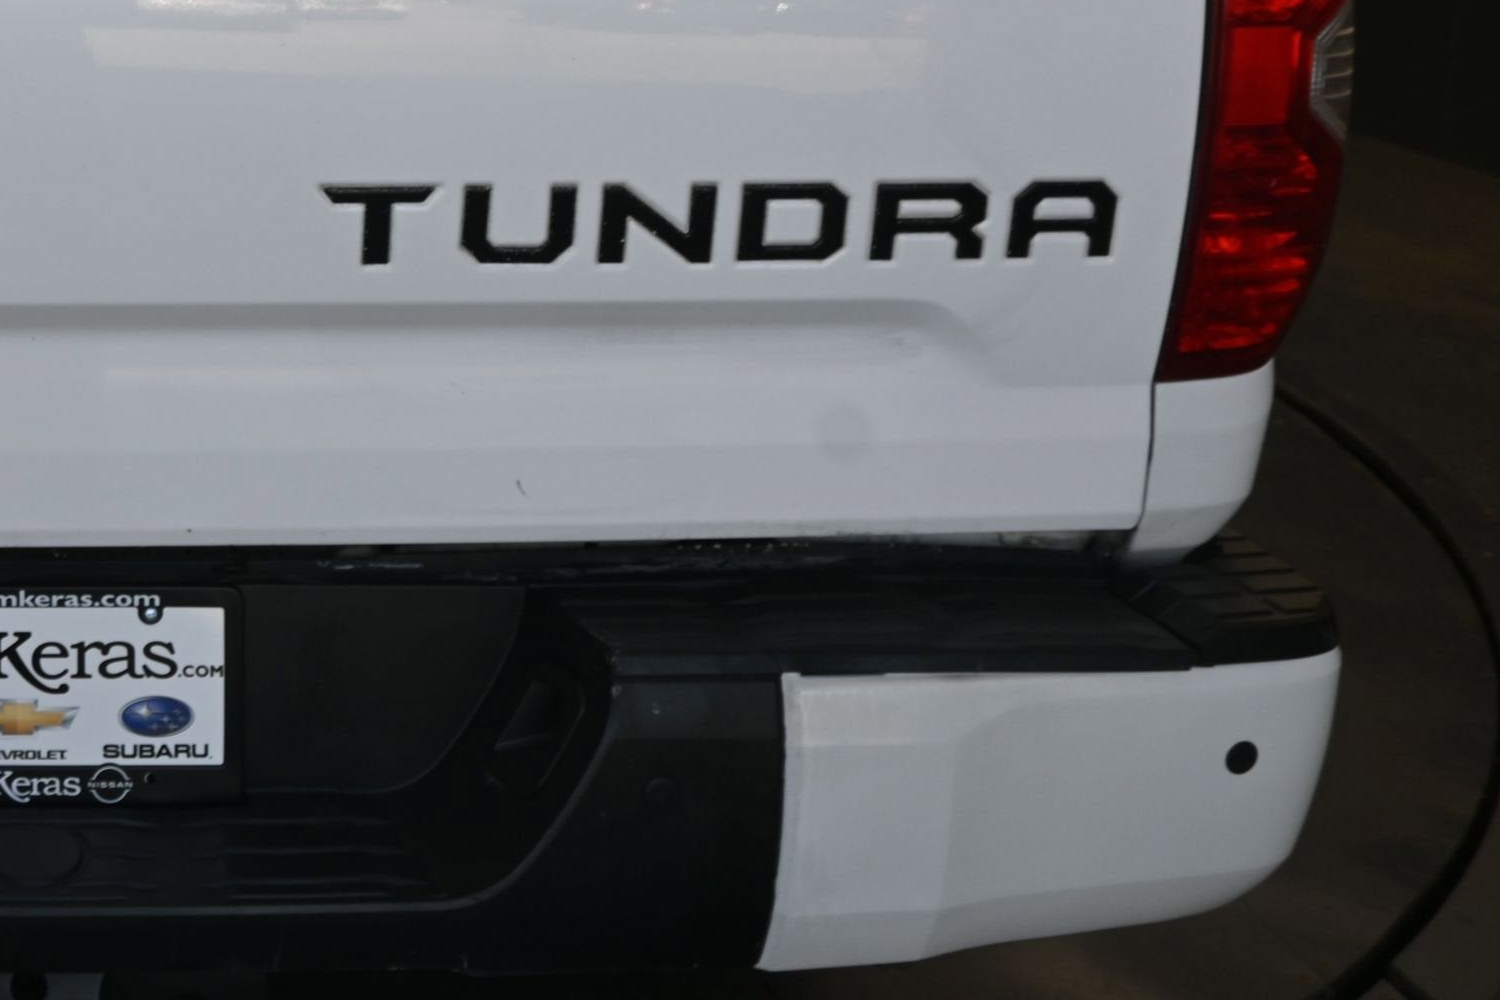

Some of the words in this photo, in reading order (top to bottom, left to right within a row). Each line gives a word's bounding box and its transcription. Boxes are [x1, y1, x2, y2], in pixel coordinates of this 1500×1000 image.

[318, 180, 1119, 265] TUNDRA
[102, 742, 210, 760] SUBARU
[86, 780, 134, 789] NISSAN
